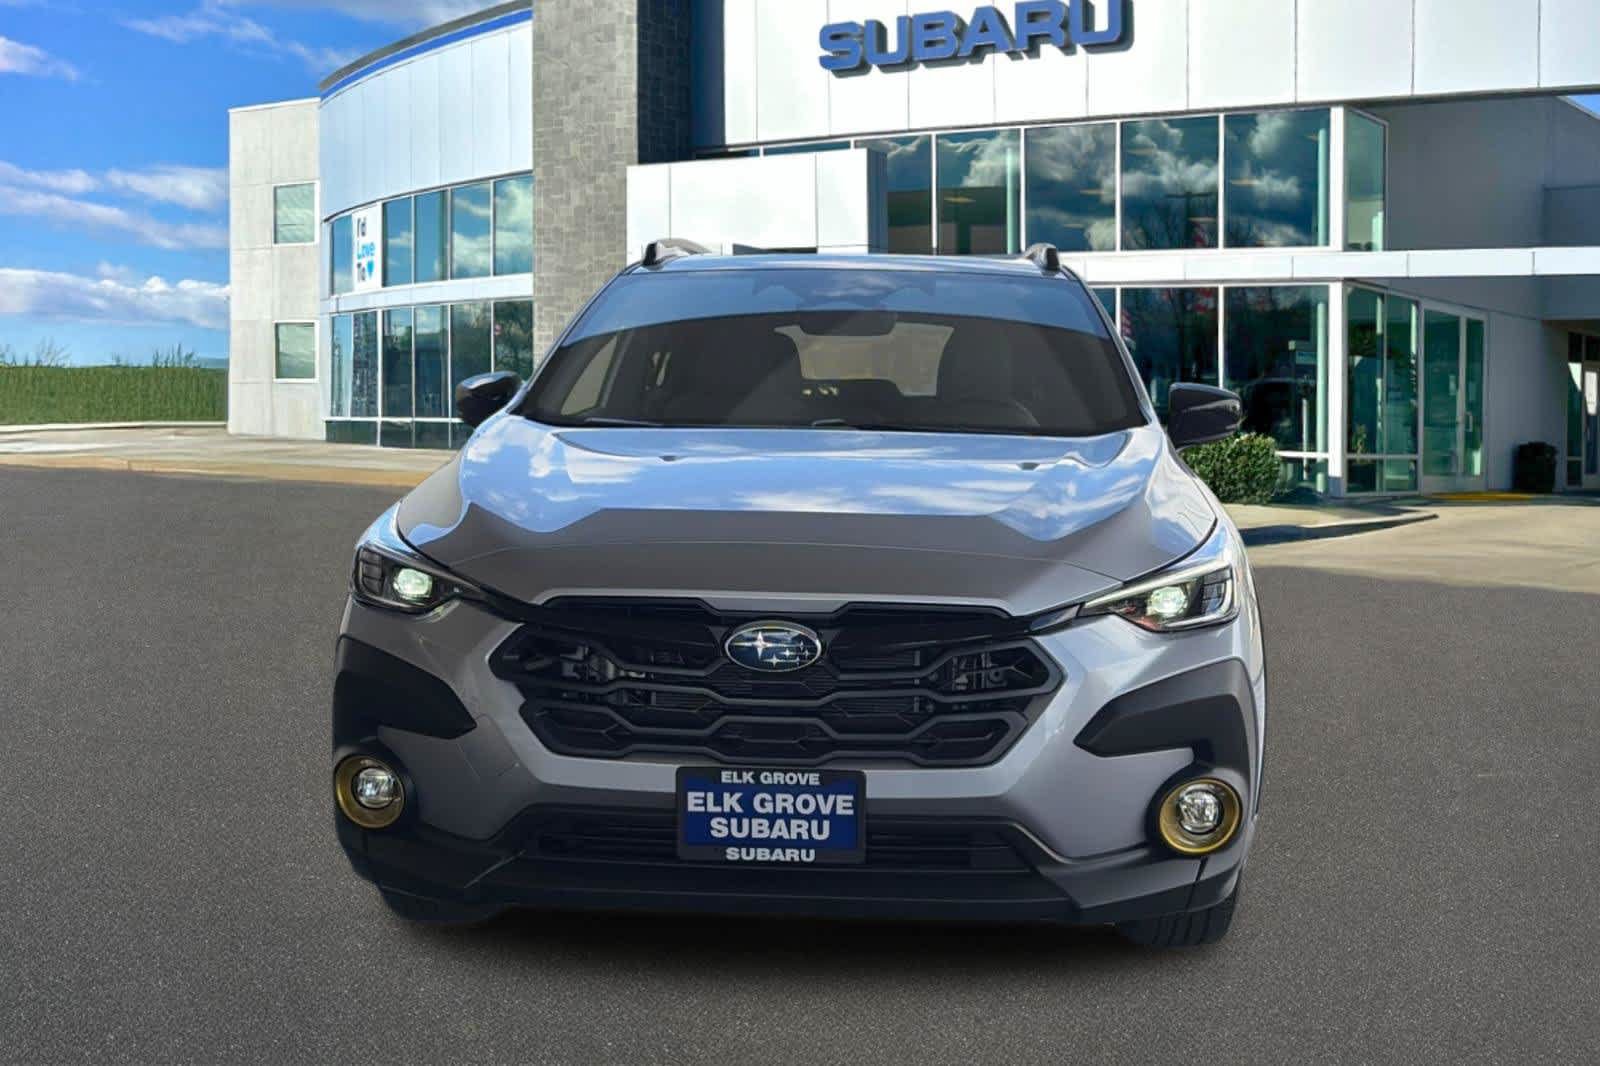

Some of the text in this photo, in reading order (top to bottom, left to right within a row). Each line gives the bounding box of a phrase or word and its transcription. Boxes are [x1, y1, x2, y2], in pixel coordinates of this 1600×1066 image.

[819, 0, 1134, 78] SUBARU
[721, 771, 820, 786] ELK GROVE
[687, 791, 854, 815] ELK GROVE
[710, 817, 830, 840] SUBARU
[726, 847, 816, 861] SUBARU
